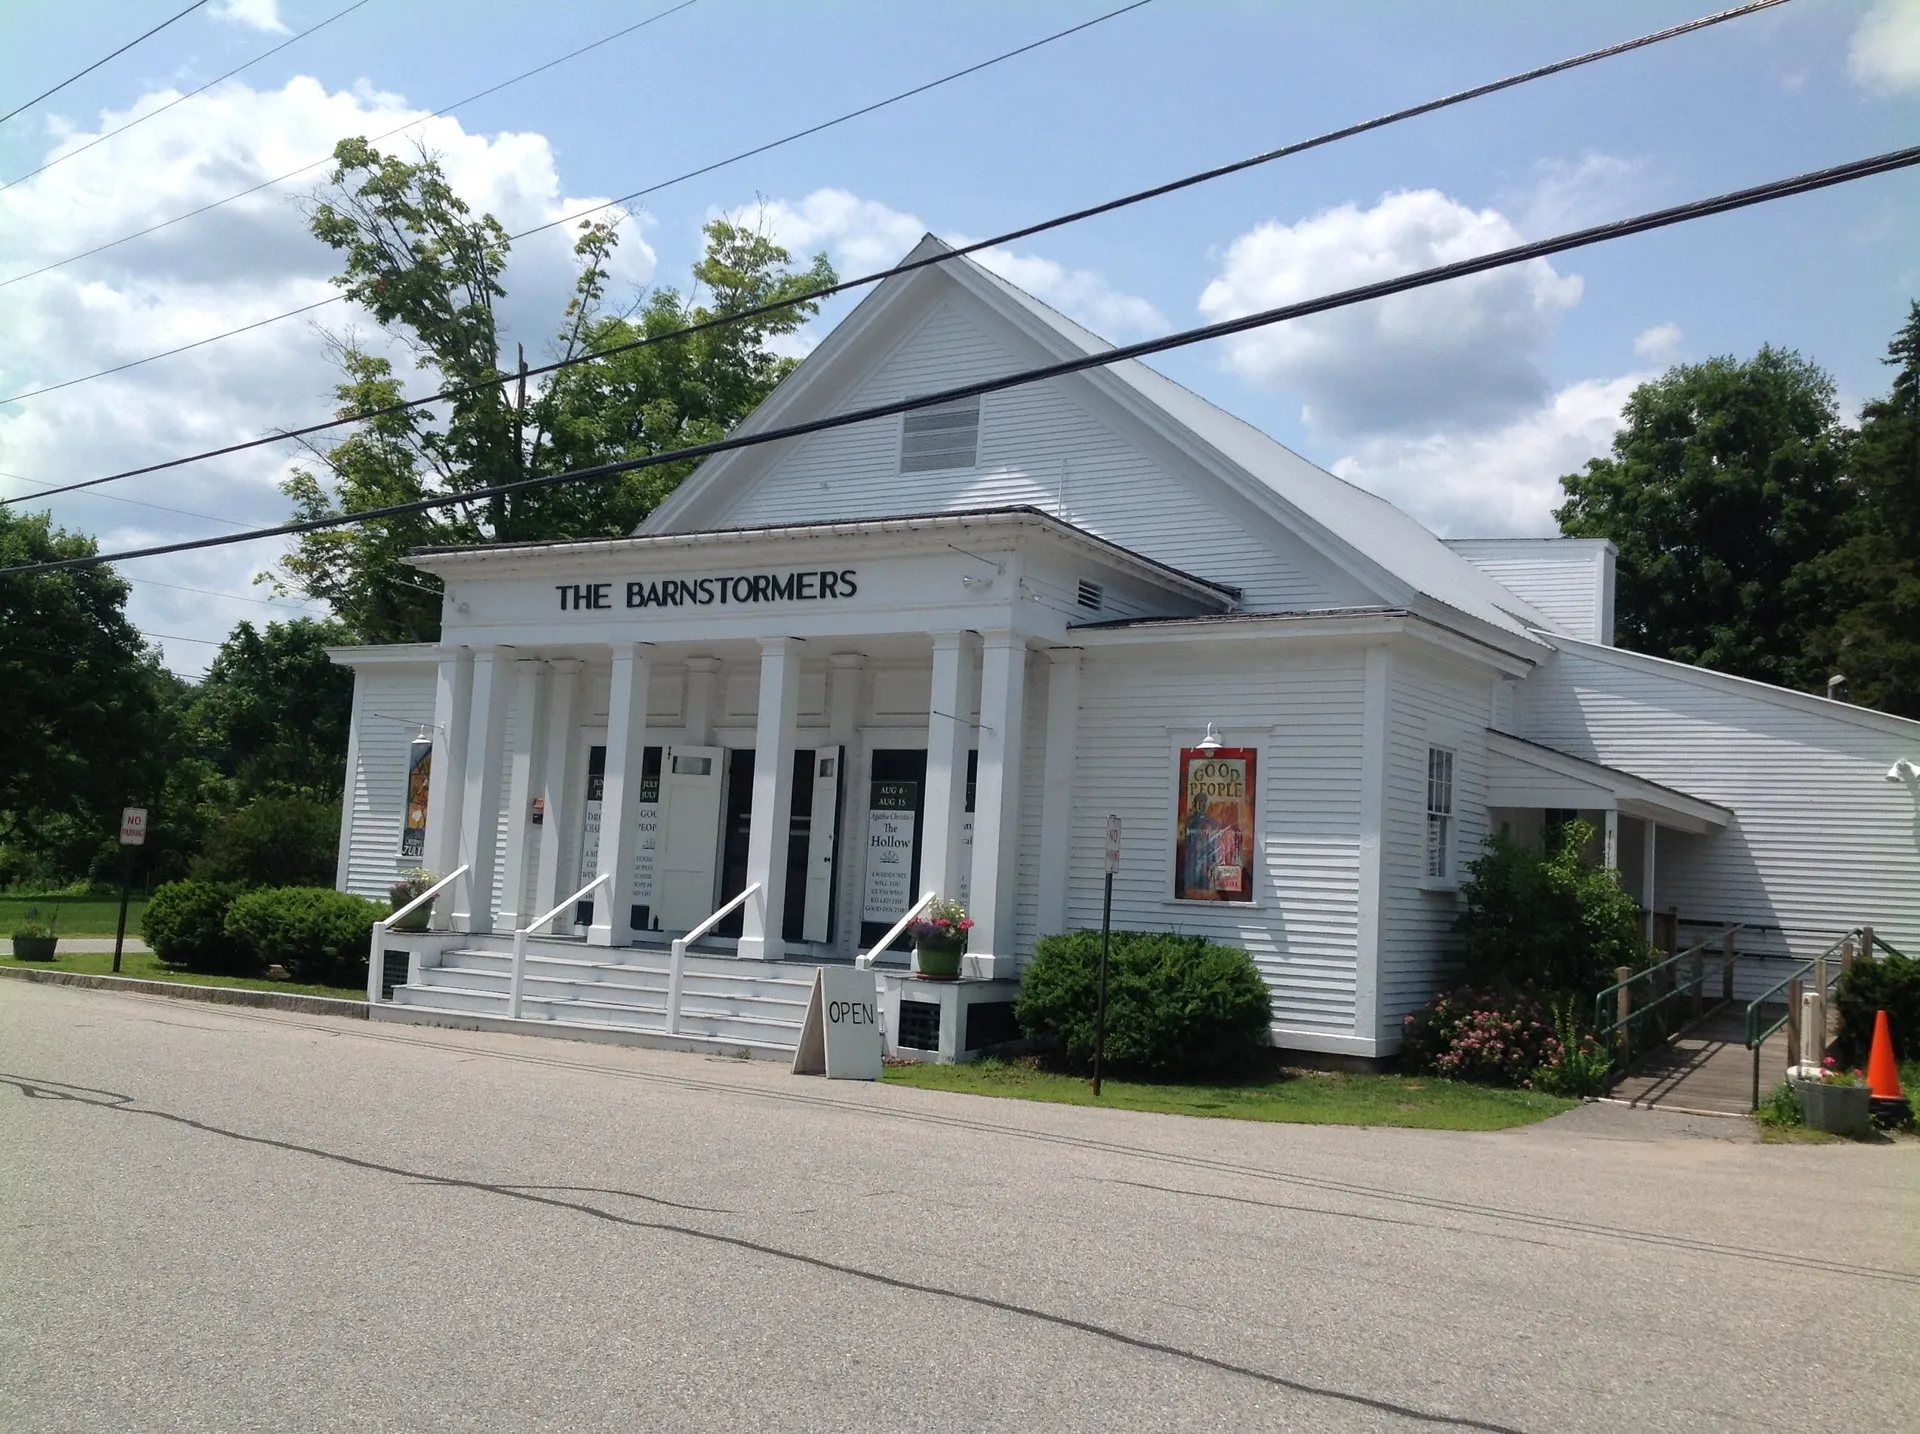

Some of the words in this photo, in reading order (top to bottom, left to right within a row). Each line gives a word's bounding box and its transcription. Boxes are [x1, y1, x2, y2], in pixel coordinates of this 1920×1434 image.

[555, 583, 612, 610] THE
[626, 570, 857, 608] BARNSTORMERS
[1194, 763, 1240, 782] GOOD
[881, 786, 896, 794] AUG
[1190, 782, 1242, 797] PEOPLE
[879, 798, 895, 806] AUG
[127, 816, 141, 825] NO
[883, 823, 898, 833] The
[871, 836, 910, 848] Hollow
[1109, 829, 1118, 843] NO
[402, 845, 422, 856] JULY
[829, 1001, 874, 1024] OPEN
